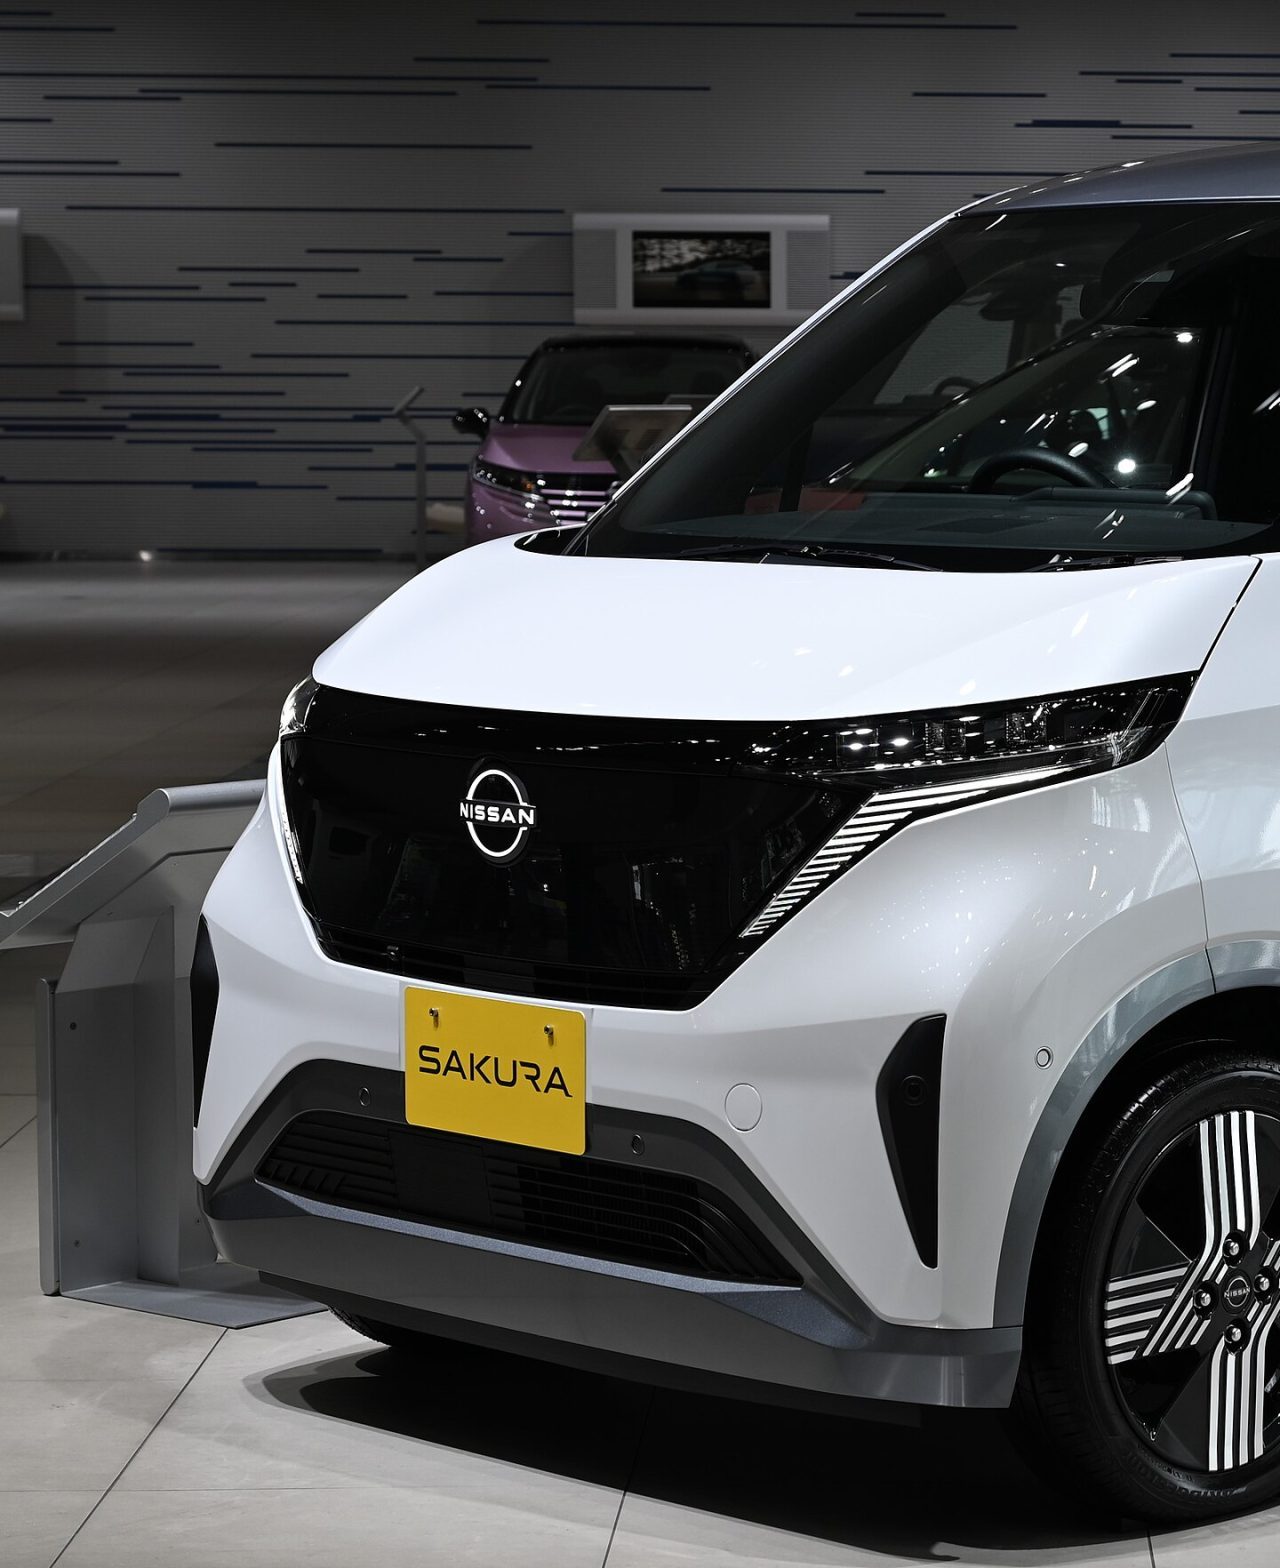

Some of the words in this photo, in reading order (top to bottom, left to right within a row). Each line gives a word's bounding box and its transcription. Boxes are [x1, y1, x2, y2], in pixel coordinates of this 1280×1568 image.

[459, 801, 535, 825] NISSAN
[418, 1044, 573, 1098] SAKURA
[1223, 1286, 1251, 1299] NISSAN
